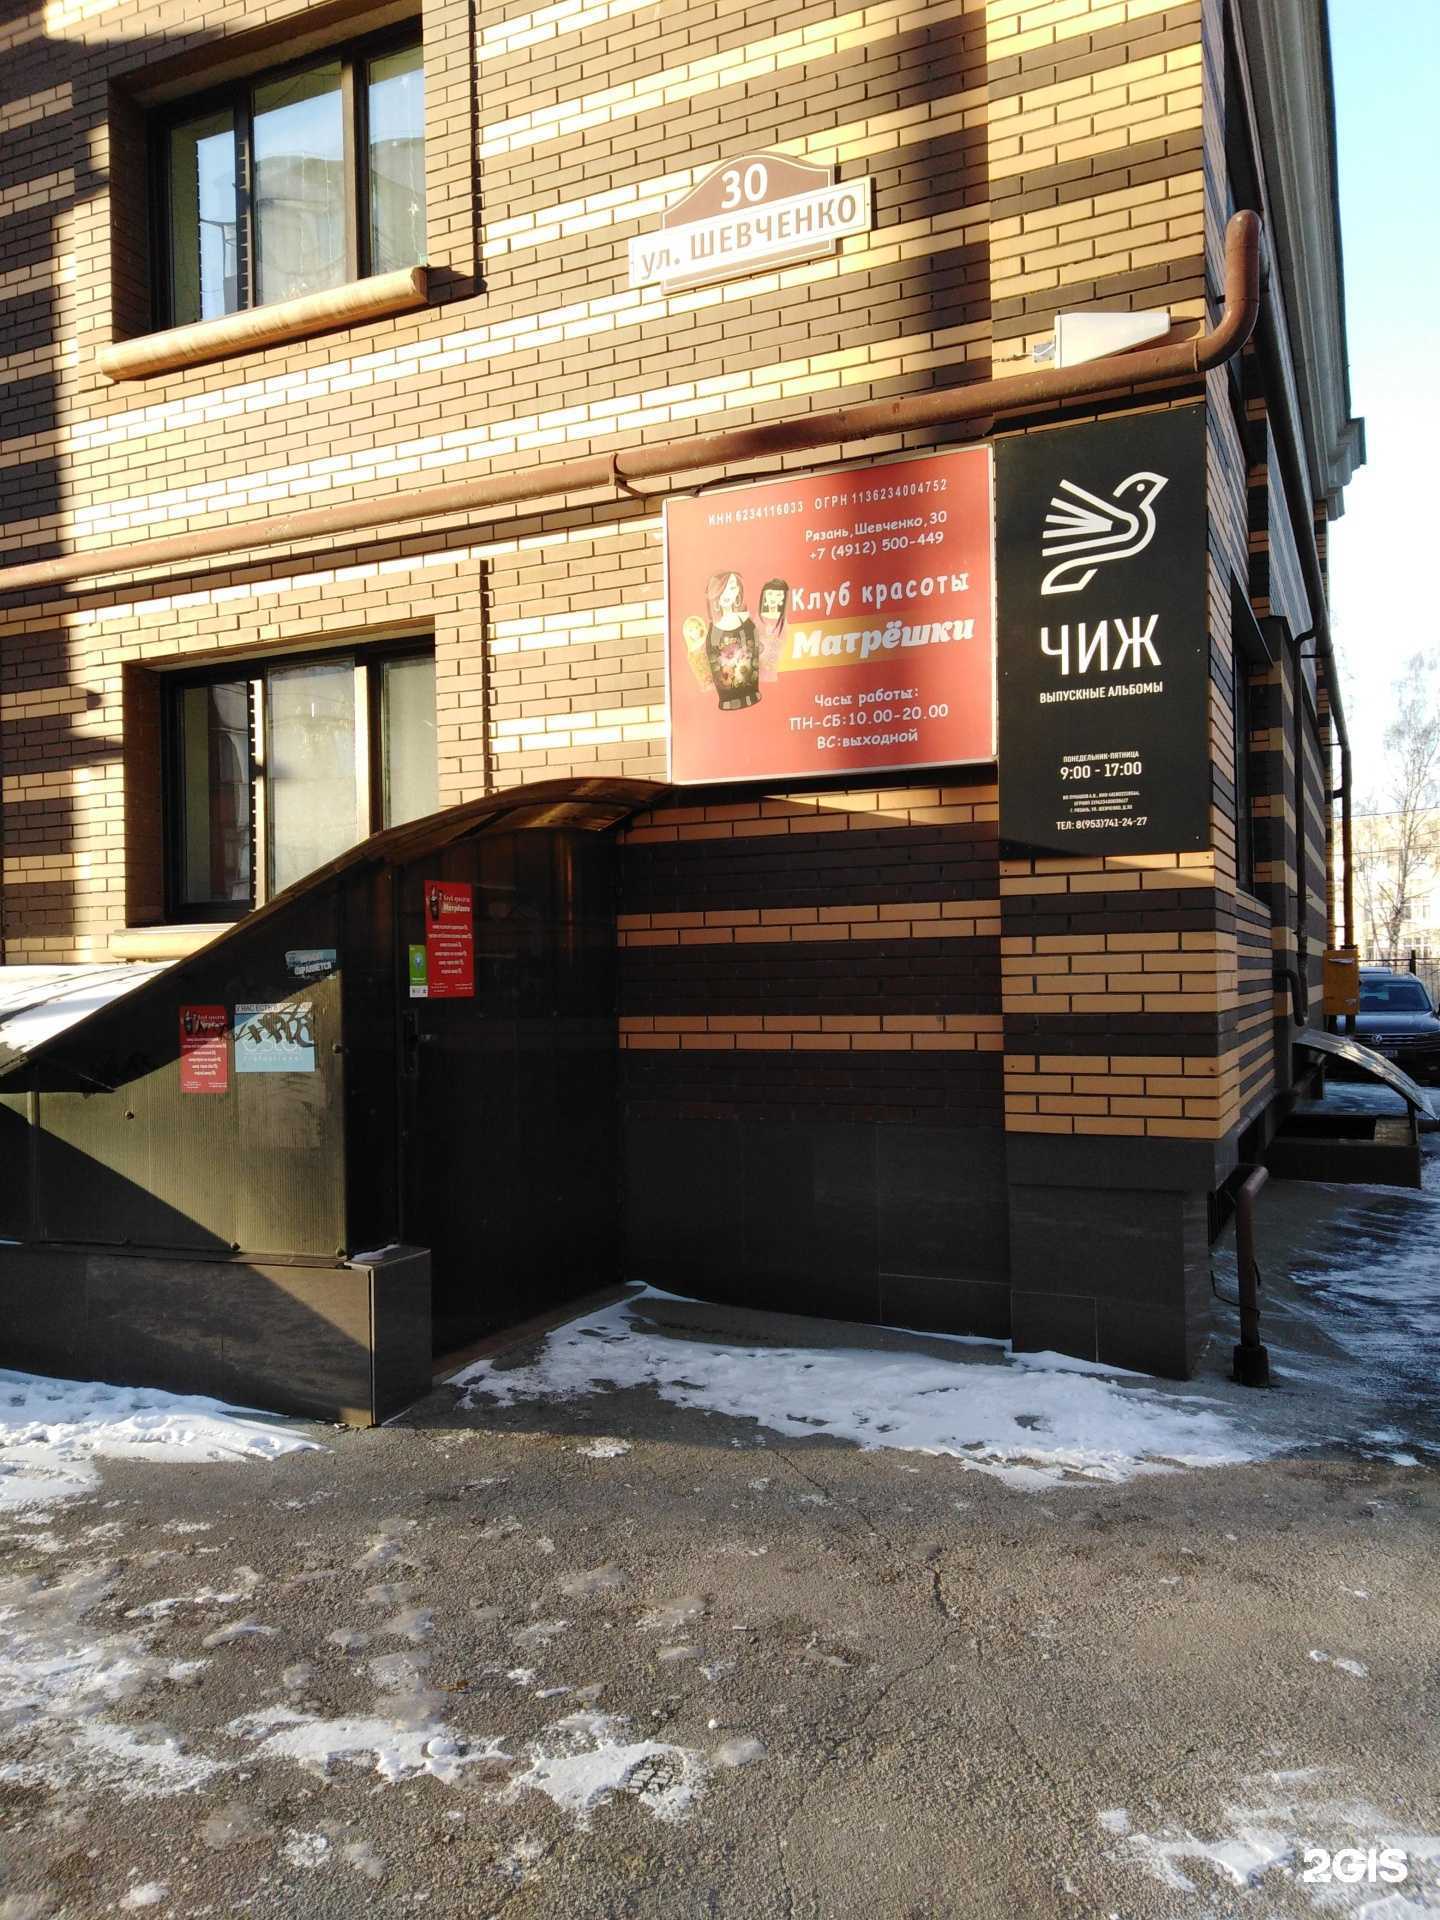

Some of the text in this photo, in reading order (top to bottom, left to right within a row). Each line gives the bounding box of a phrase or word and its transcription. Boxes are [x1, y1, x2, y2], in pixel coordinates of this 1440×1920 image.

[720, 163, 768, 209] 30
[640, 194, 856, 280] ул. ШЕВЧЕНКО
[708, 511, 733, 527] ИНН
[814, 494, 848, 511] ОГРН
[851, 478, 948, 505] 1136234004752
[808, 531, 944, 561] +7 (4912) 500-449
[791, 572, 970, 616] Клуб красоты
[791, 618, 976, 660] Матрёшки
[1040, 613, 1162, 676] ЧИЖ
[814, 687, 919, 708] Часы работы:
[1039, 681, 1164, 704] ВЫПУСКНЫЕ АЛЬБОМЫ
[1060, 764, 1091, 780] 9:00
[1103, 761, 1142, 777] 17:00
[1055, 820, 1075, 831] ТЕЛ:
